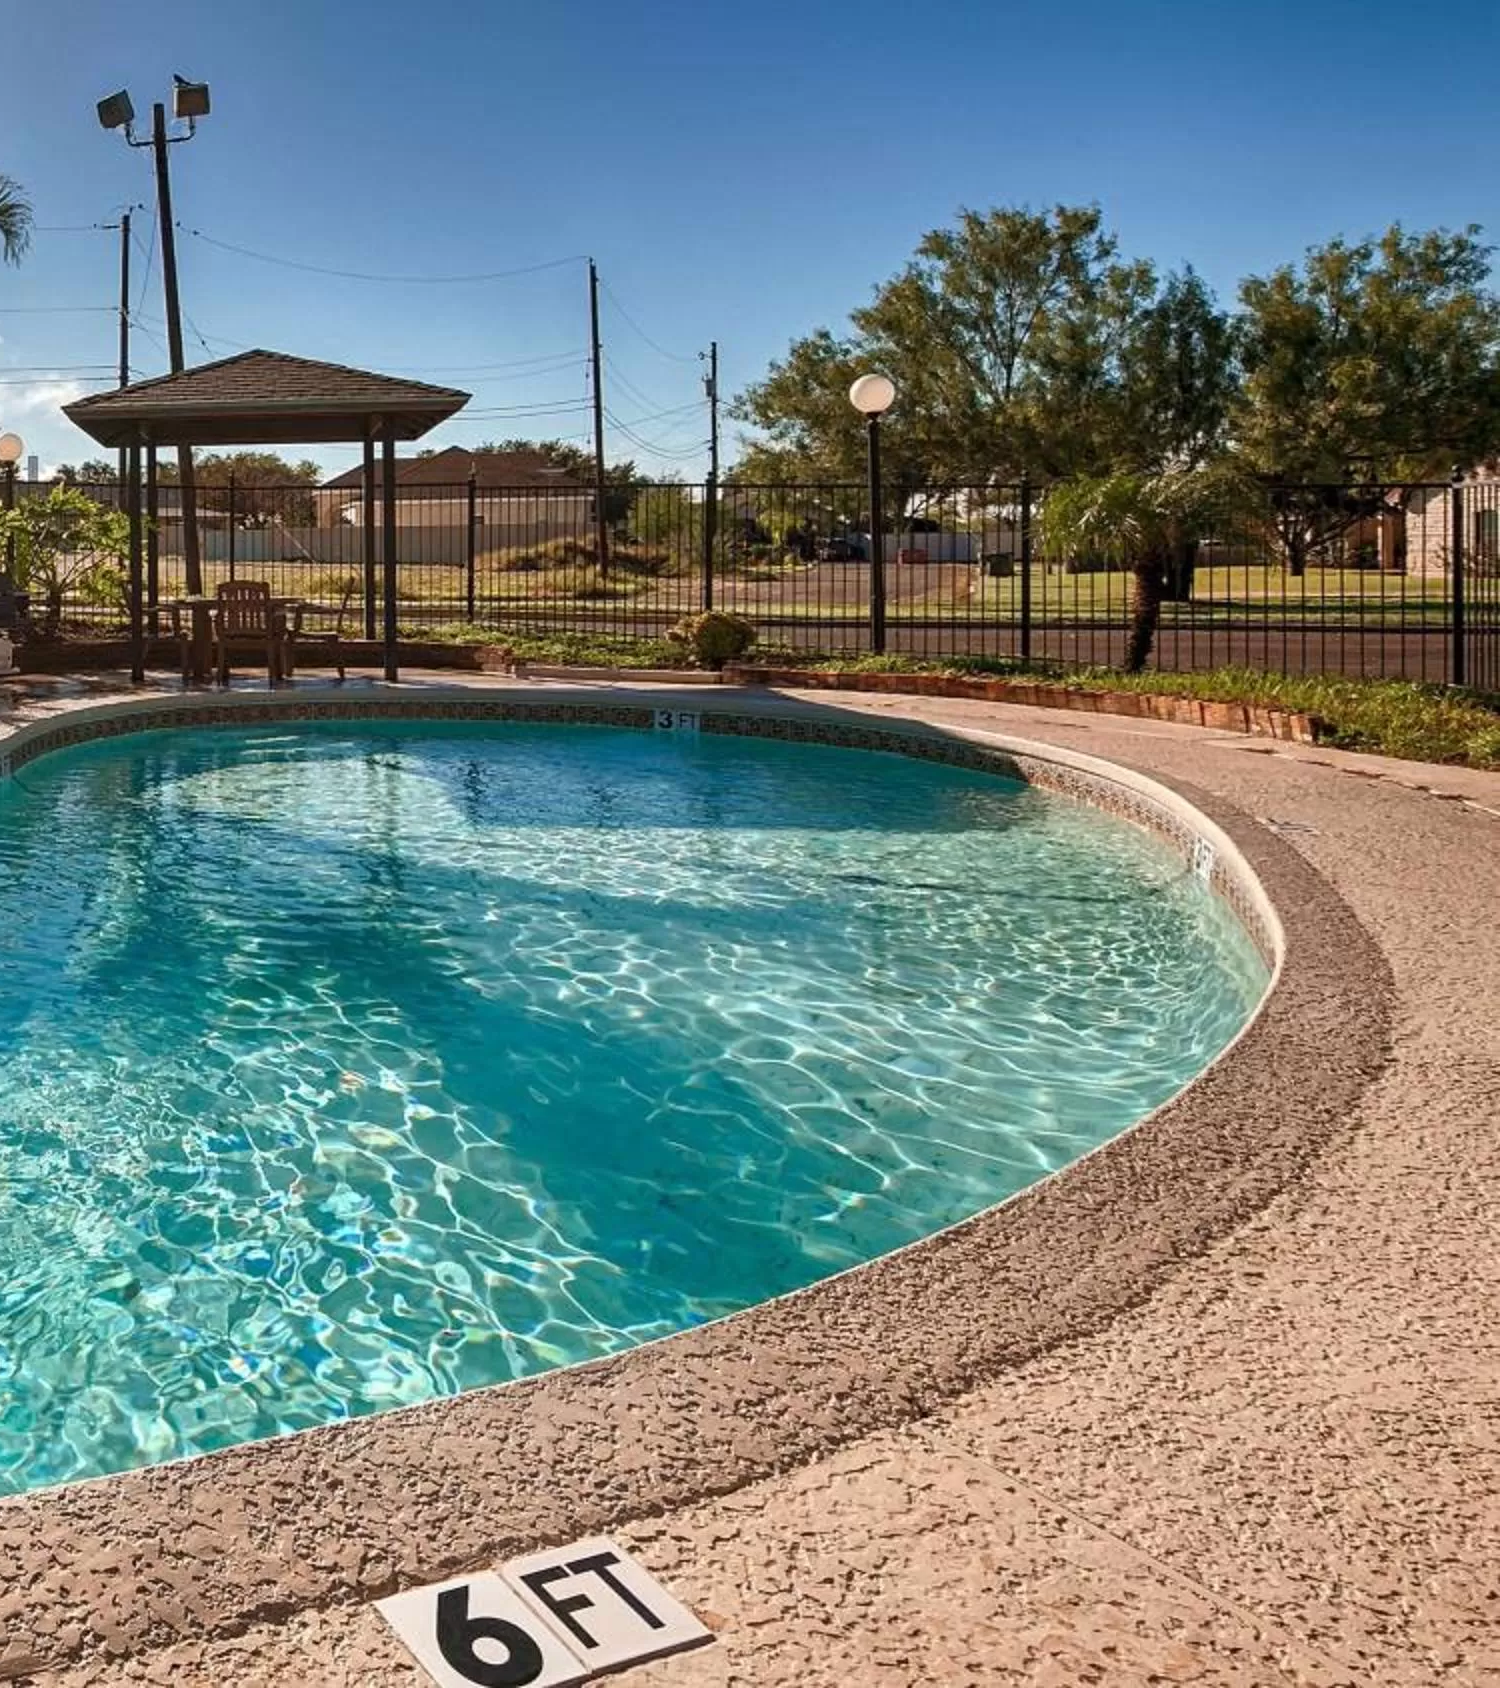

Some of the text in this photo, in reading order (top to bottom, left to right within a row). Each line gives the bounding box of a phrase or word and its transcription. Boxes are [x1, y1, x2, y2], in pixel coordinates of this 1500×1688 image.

[658, 711, 673, 729] 3
[436, 1551, 665, 1688] 6 FT
